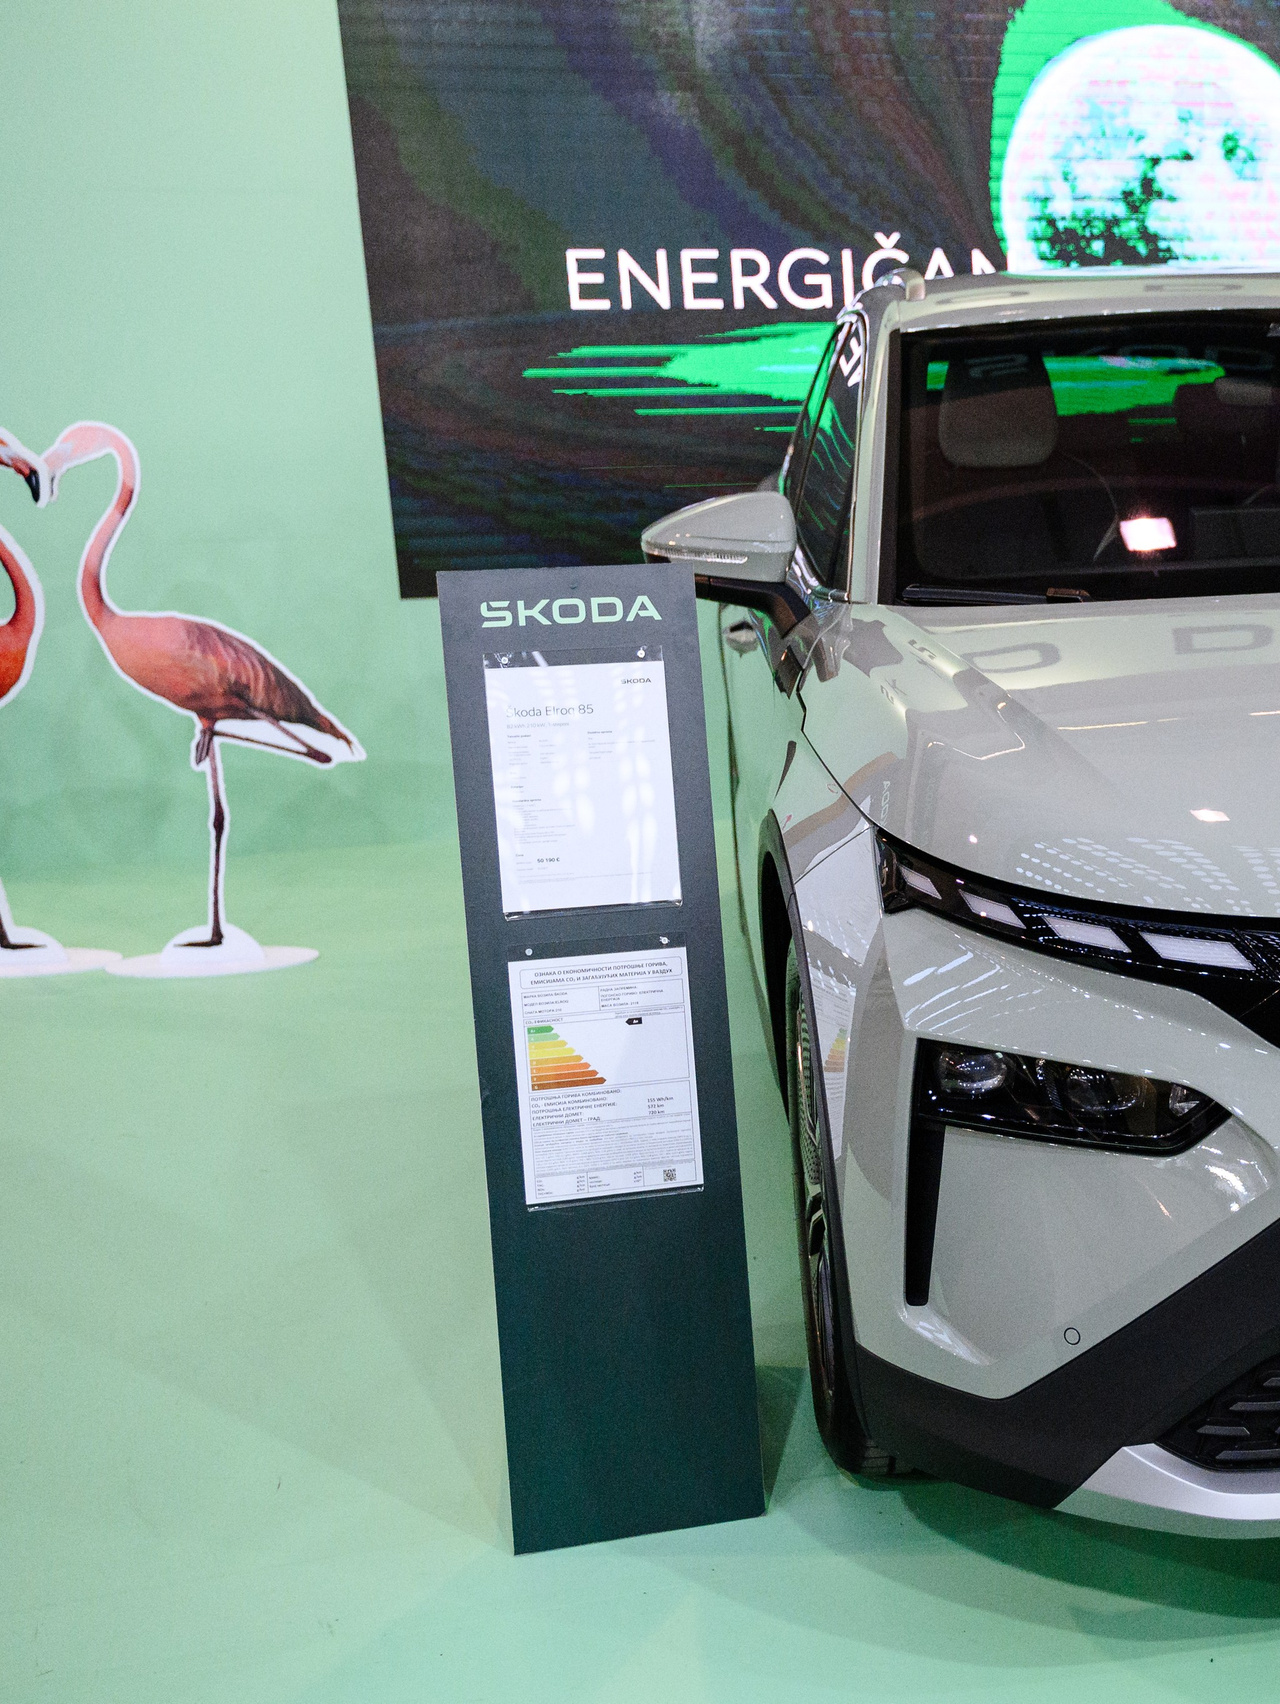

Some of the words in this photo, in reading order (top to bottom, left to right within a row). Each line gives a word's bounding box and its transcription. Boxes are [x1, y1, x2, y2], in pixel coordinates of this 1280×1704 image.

[480, 595, 663, 628] SKODA
[578, 703, 594, 714] 85
[563, 966, 612, 975] ЕКОНОМИЧНОСТИ
[613, 963, 644, 971] ПОТРОШЊЕ
